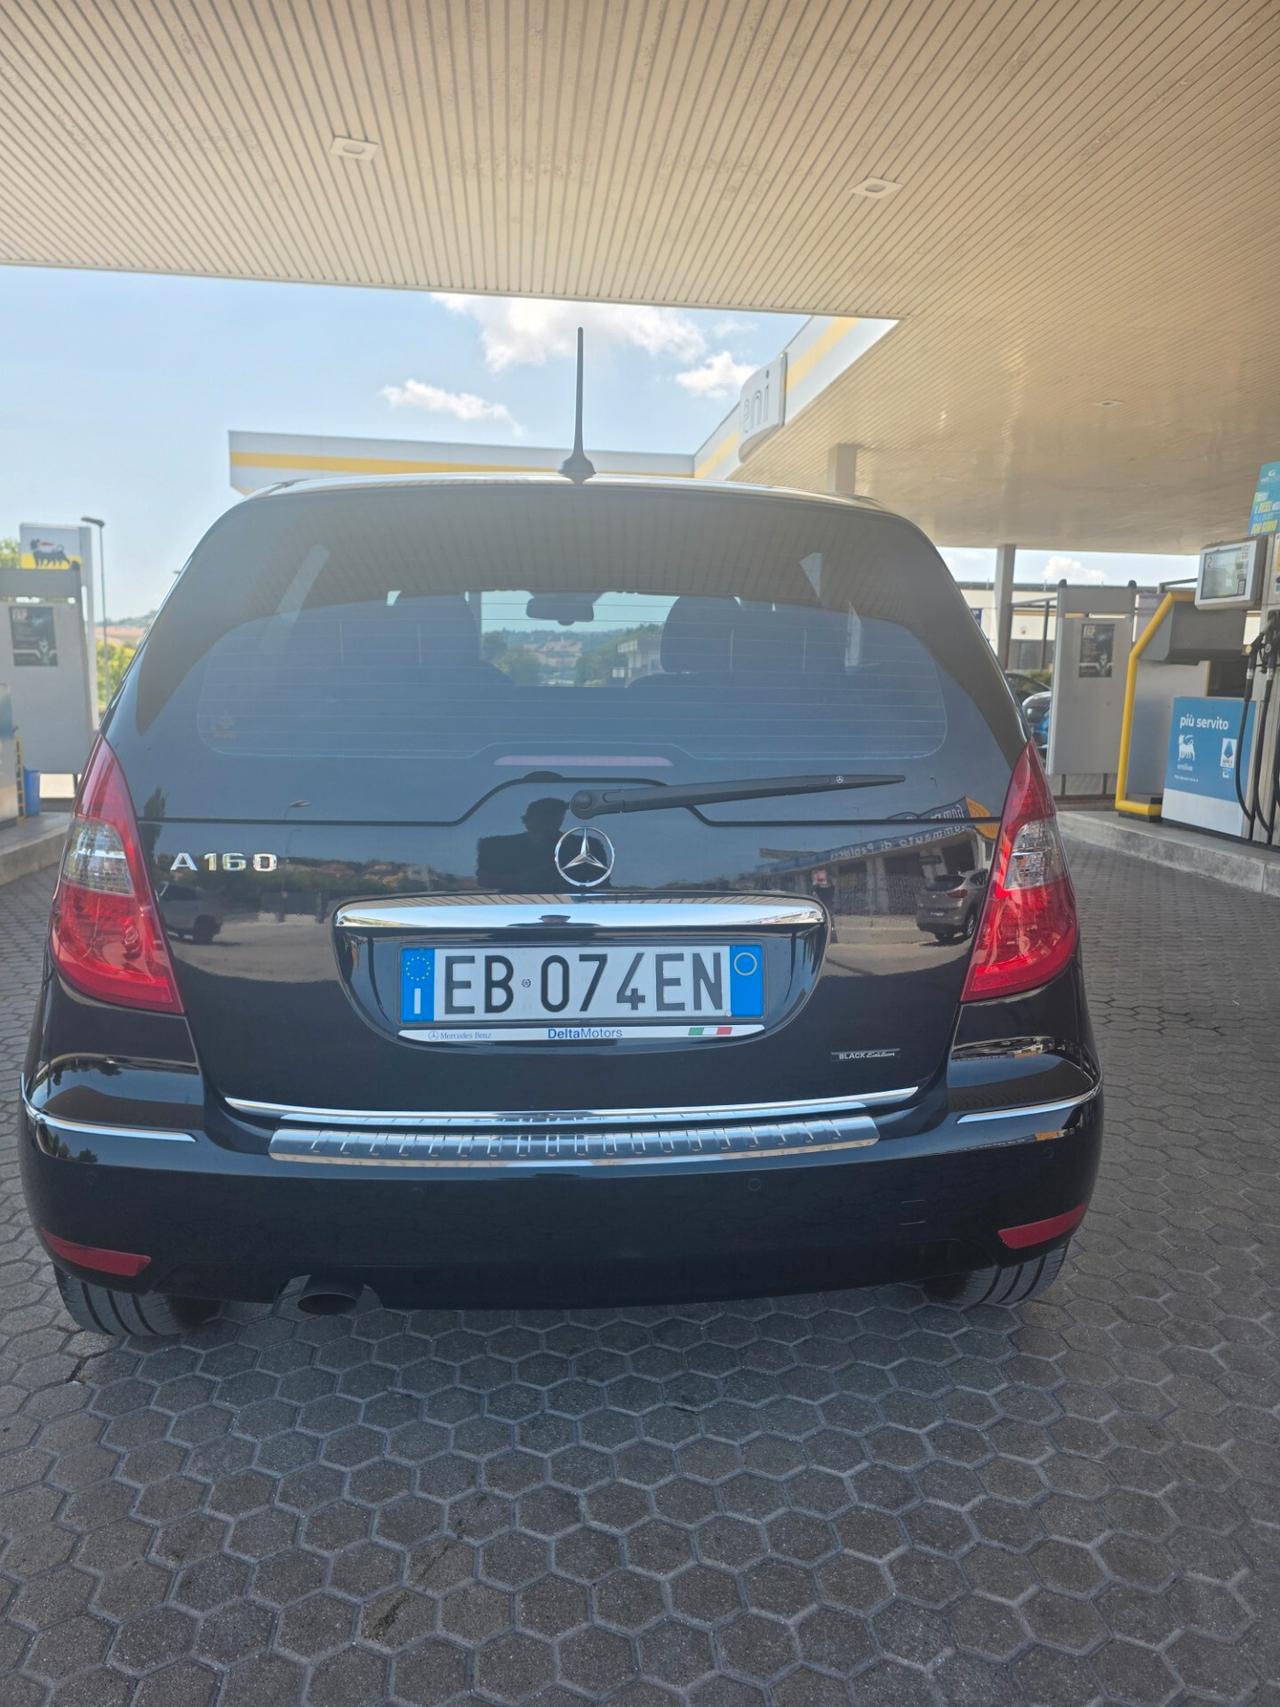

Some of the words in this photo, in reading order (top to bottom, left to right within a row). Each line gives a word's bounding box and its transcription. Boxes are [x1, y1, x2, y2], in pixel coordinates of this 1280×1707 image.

[1180, 713, 1195, 729] più
[1196, 716, 1229, 730] servito
[440, 1031, 473, 1040] Mercedes
[475, 1031, 492, 1039] Benz
[547, 1027, 623, 1039] DeltaMotors
[839, 1051, 865, 1060] BLACK
